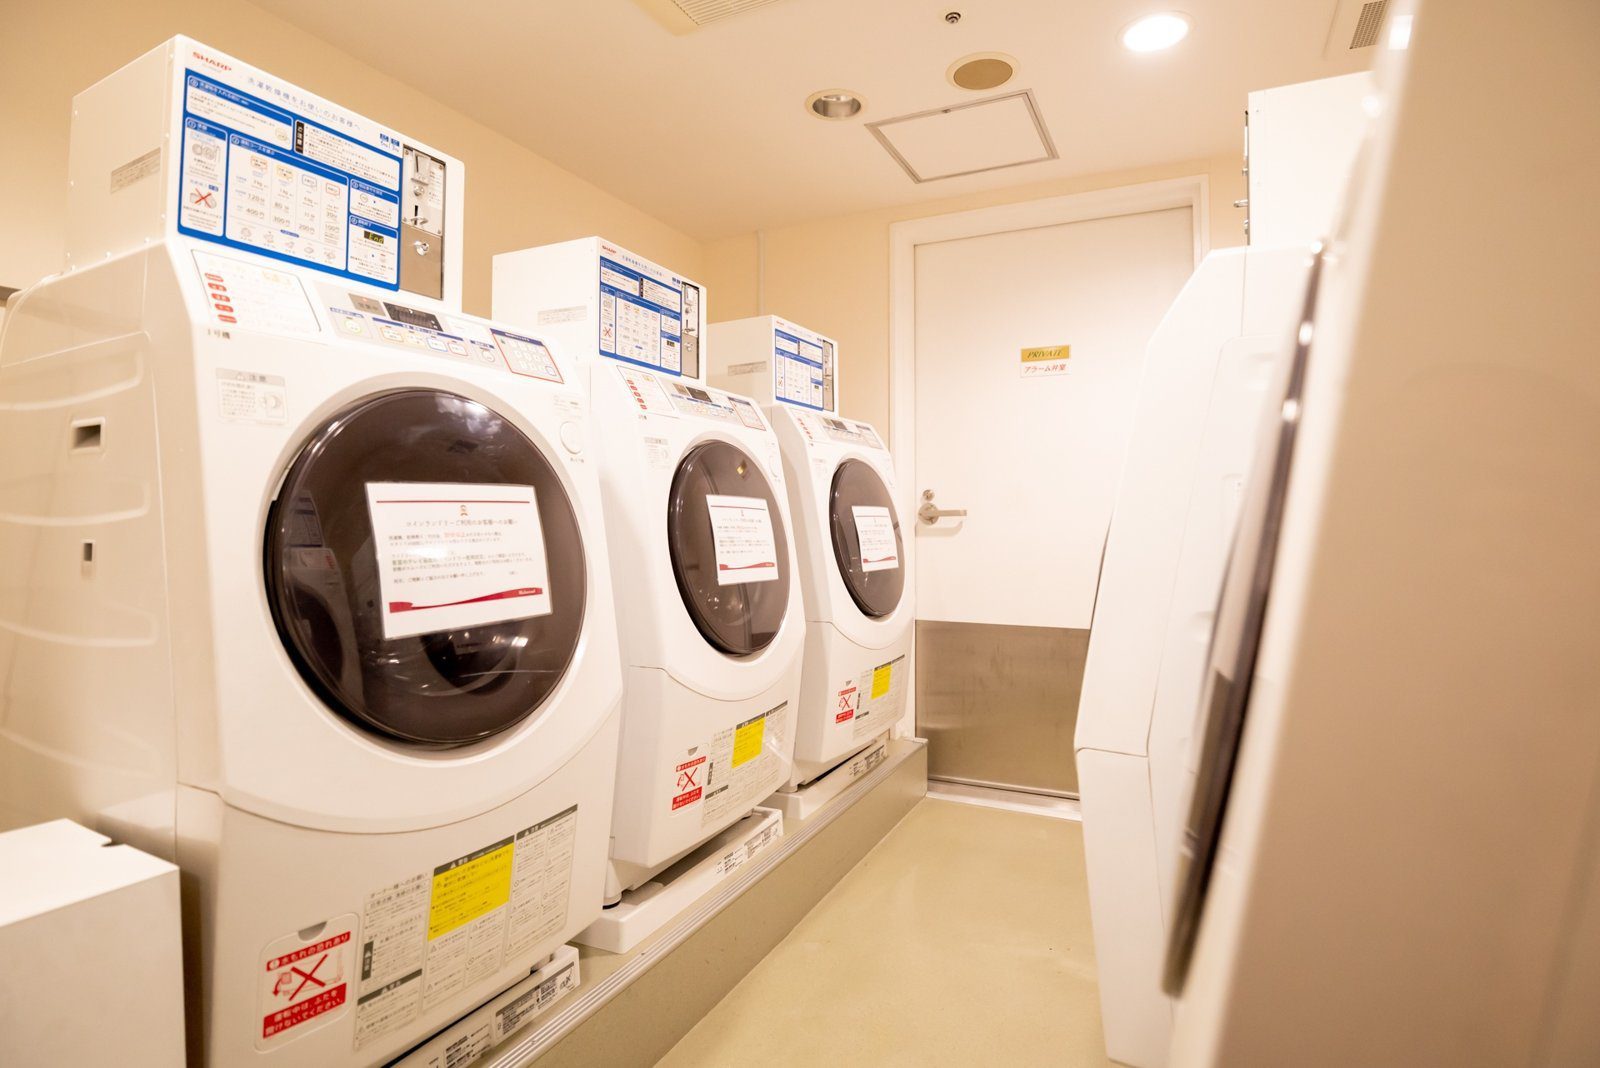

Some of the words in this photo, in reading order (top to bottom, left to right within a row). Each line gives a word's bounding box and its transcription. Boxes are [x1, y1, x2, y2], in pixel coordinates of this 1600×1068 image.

[192, 51, 232, 72] SHARP
[1027, 349, 1062, 358] PRIVATE
[281, 933, 348, 965] 水もれの恐れあり
